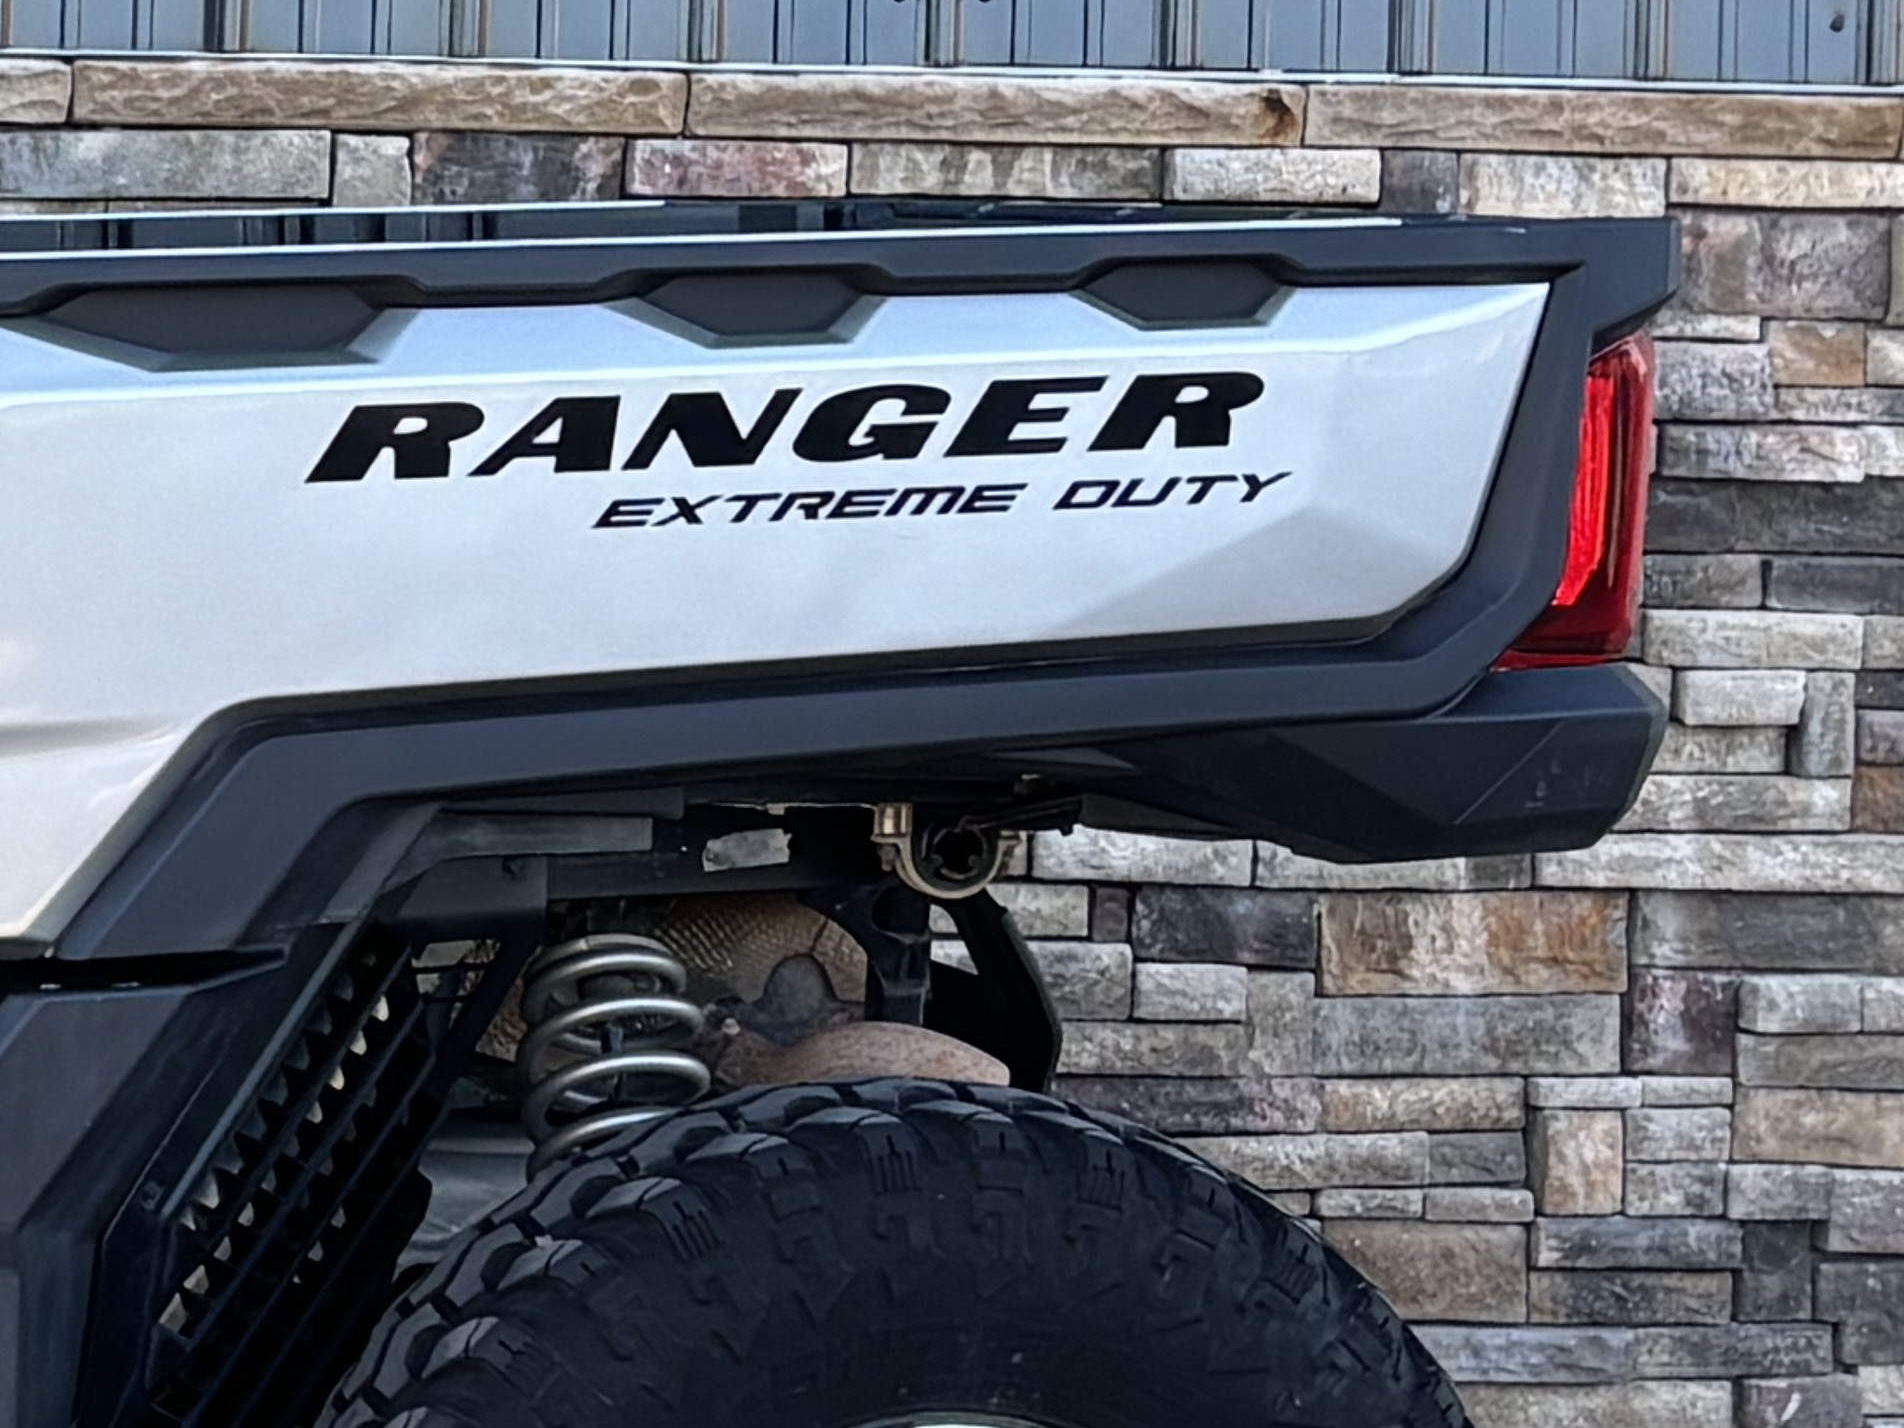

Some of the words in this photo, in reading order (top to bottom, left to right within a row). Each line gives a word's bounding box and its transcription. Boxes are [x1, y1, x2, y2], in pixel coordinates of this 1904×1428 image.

[305, 371, 1265, 484] RANGER
[593, 483, 1028, 529] EXTREME
[1053, 472, 1291, 510] DUTY
